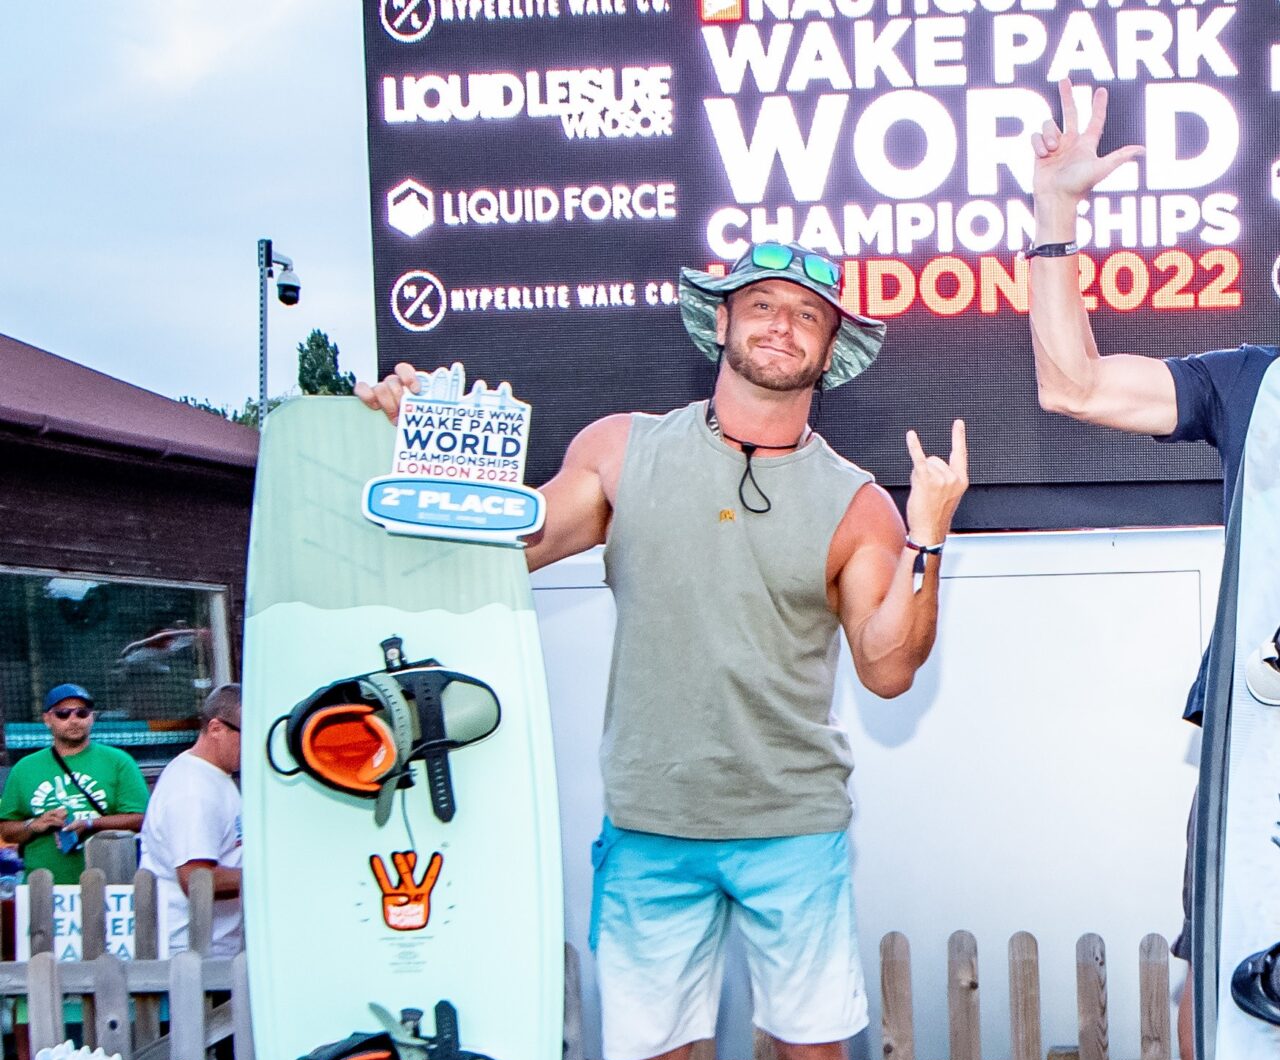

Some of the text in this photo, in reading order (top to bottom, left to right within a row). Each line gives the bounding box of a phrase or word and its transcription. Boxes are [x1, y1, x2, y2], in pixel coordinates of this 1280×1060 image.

[702, 7, 1239, 94] WAKE PARK
[443, 184, 677, 226] LIQUID FORCE
[450, 284, 570, 311] HYPERLITE
[577, 282, 636, 308] WAKE
[404, 413, 523, 436] WAKE PARK
[415, 404, 525, 422] NAUTIQUE WWA
[403, 428, 521, 457] WORLD
[396, 462, 518, 482] LONDON 2022
[399, 450, 519, 470] CHAMPIONSHIPS
[418, 490, 526, 517] PLACE
